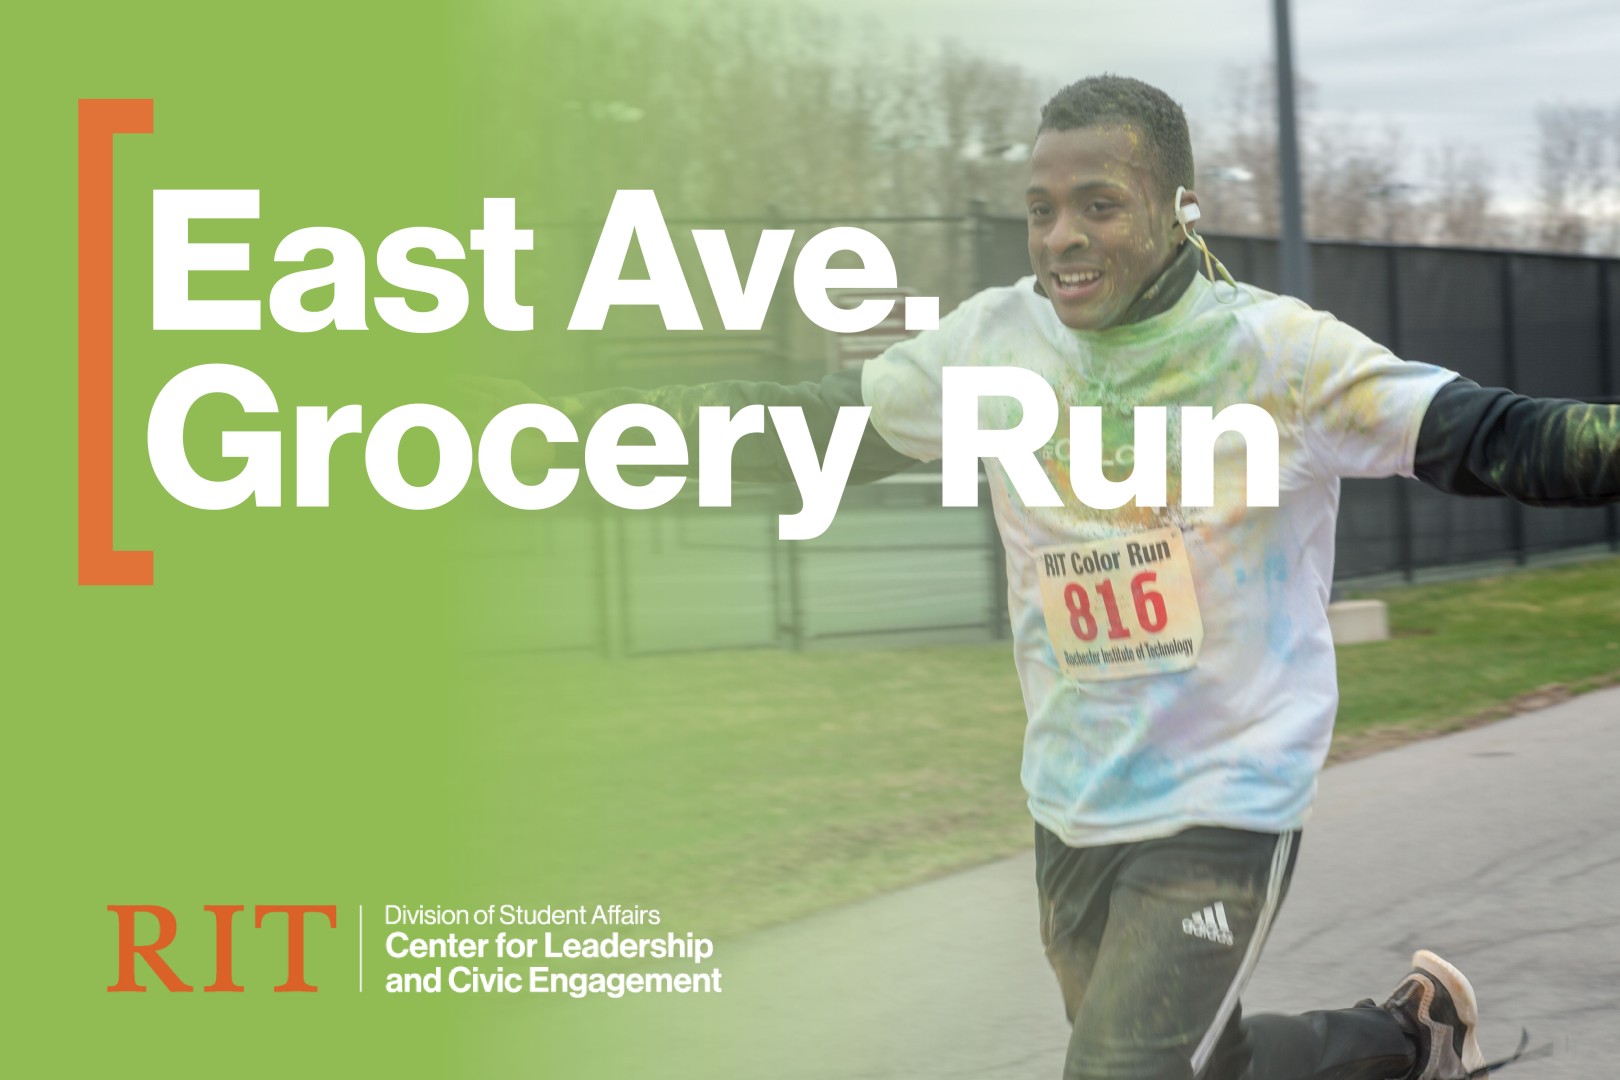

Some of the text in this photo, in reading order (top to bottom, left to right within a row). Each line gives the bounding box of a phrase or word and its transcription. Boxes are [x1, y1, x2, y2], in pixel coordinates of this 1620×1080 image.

[1044, 541, 1170, 576] RIT Color Run
[1063, 571, 1168, 642] 816
[1064, 638, 1193, 665] Rochester Institute of Technology
[1182, 918, 1234, 946] adidas
